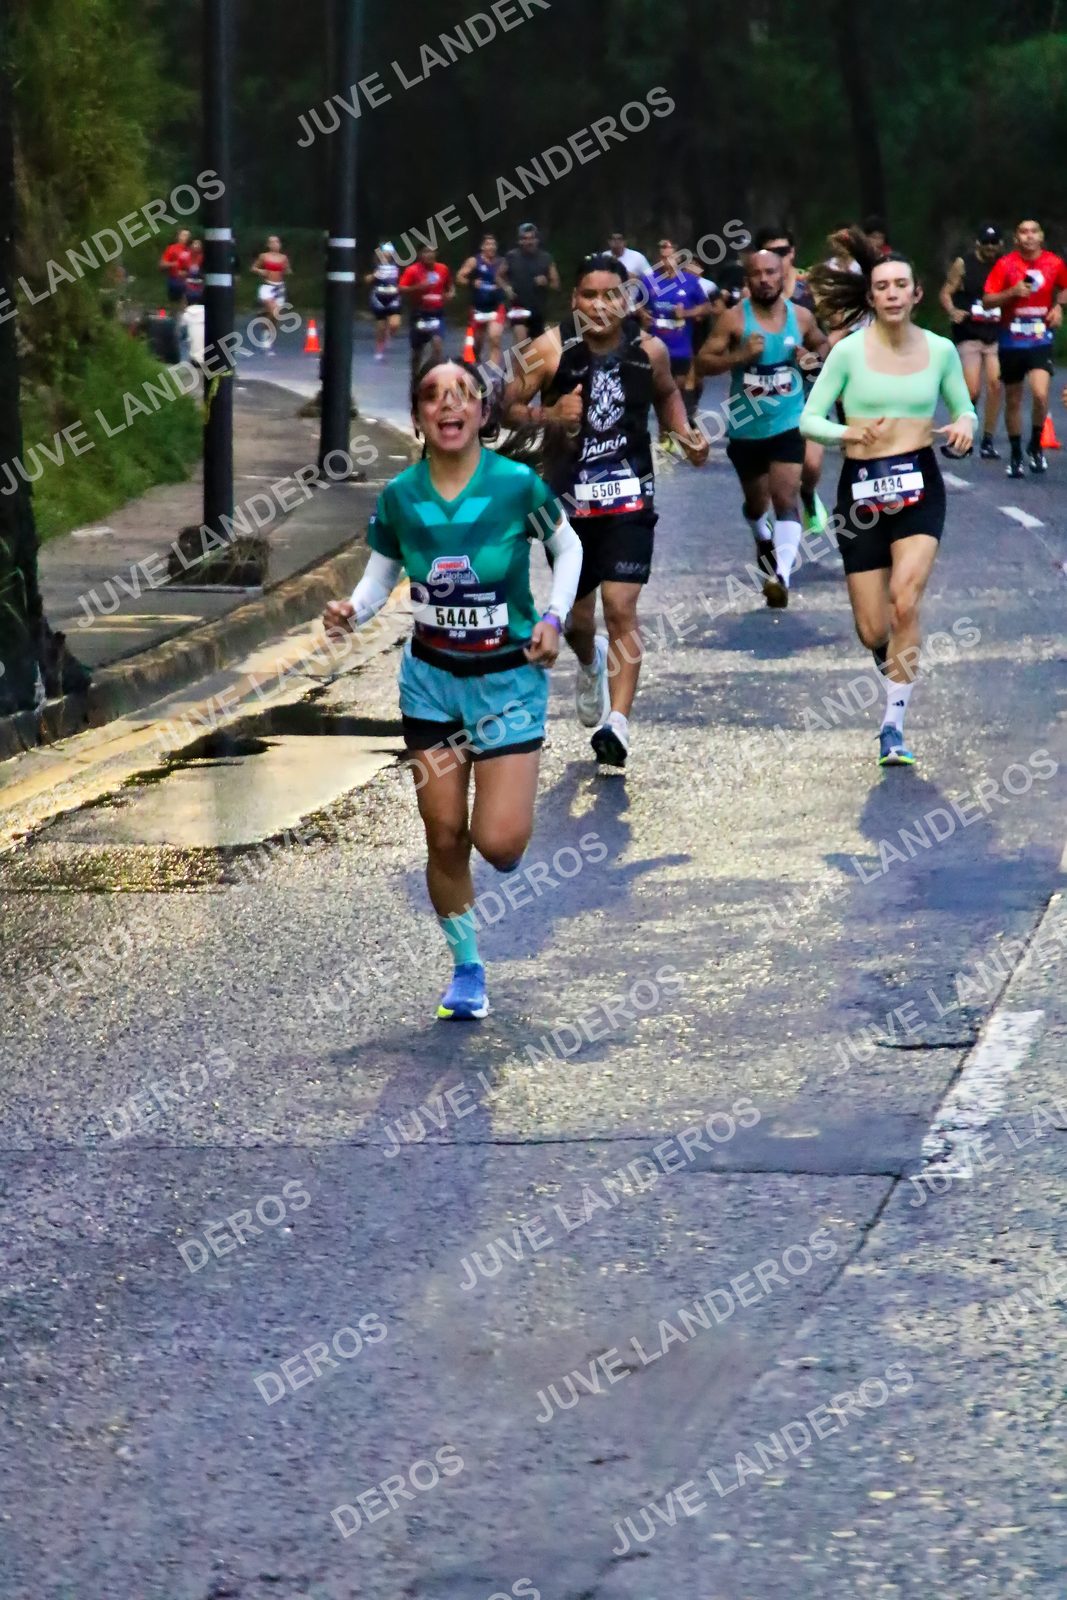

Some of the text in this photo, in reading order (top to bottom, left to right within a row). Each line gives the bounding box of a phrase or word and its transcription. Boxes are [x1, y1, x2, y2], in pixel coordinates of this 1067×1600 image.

[591, 482, 621, 499] 5506
[873, 477, 903, 493] 4434
[435, 607, 479, 627] 5444
